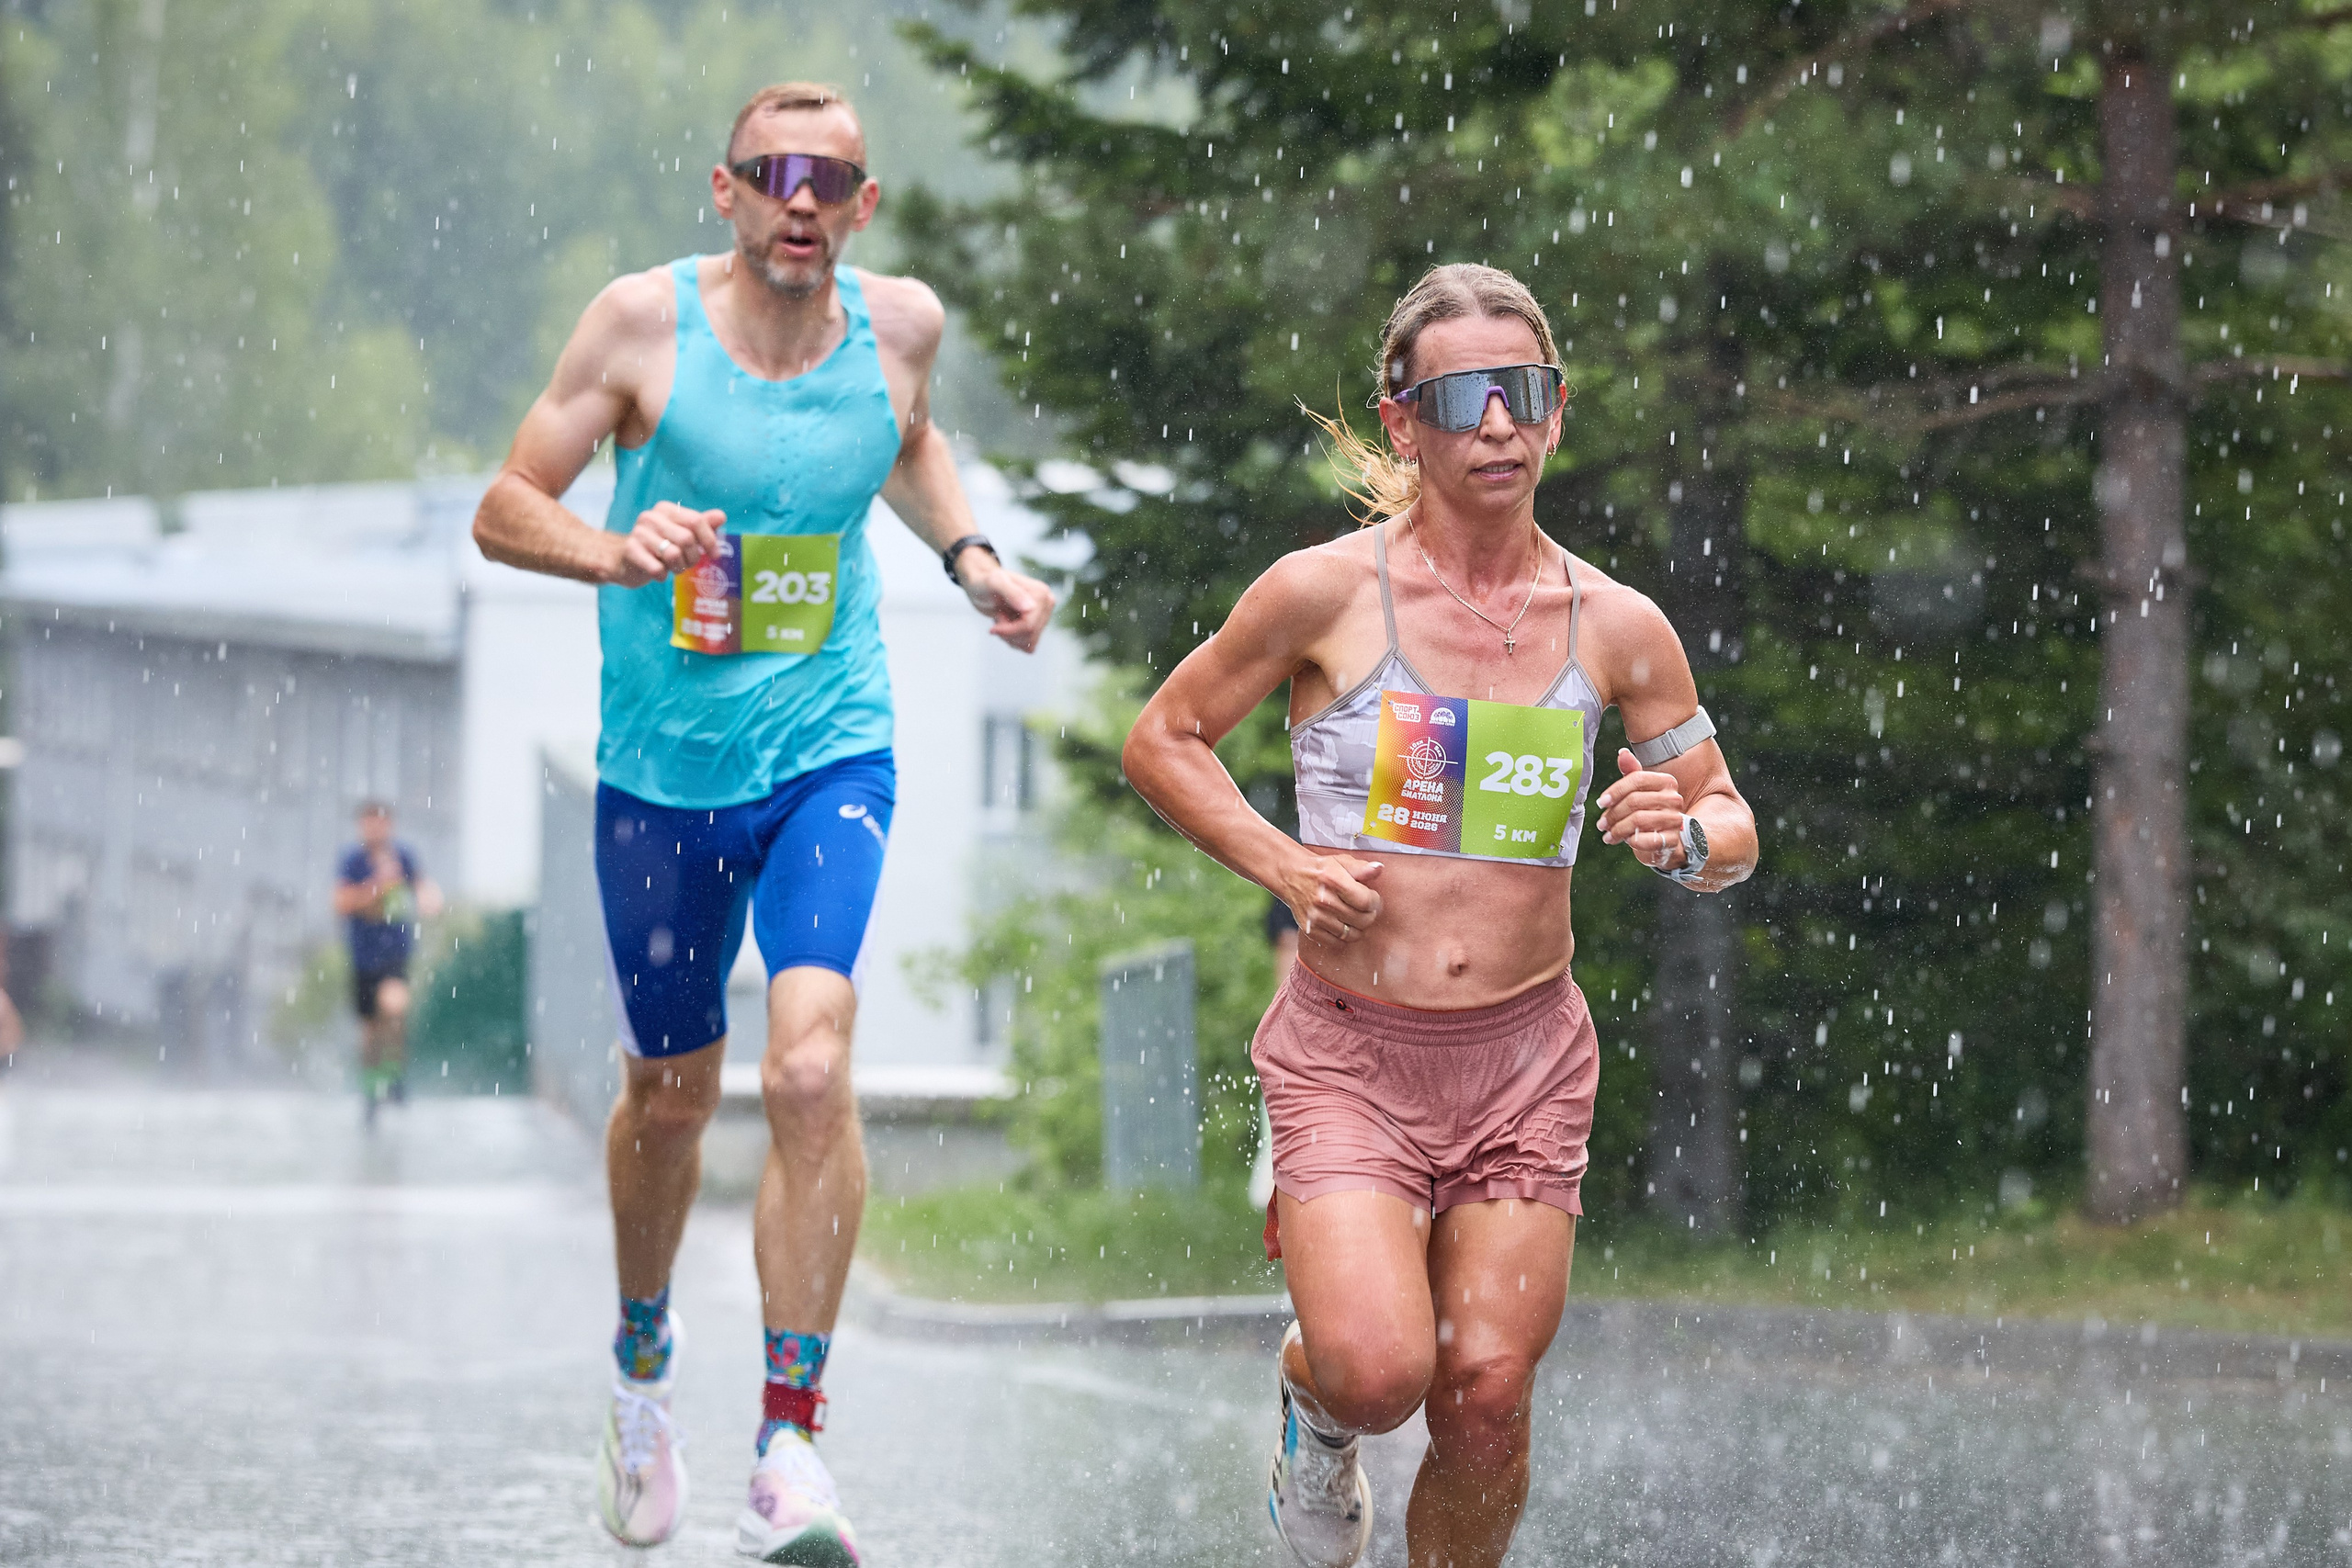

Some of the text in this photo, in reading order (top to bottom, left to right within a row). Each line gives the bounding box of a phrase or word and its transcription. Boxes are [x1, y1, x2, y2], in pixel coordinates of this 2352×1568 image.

[751, 570, 832, 605] 203
[1397, 713, 1419, 721] СОЮЗ
[1479, 750, 1573, 799] 283
[1403, 778, 1444, 795] АРЕНА
[1400, 789, 1443, 803] БИАТЛОНА
[1377, 803, 1448, 826] 28 ИЮНЯ
[1493, 823, 1507, 840] 5
